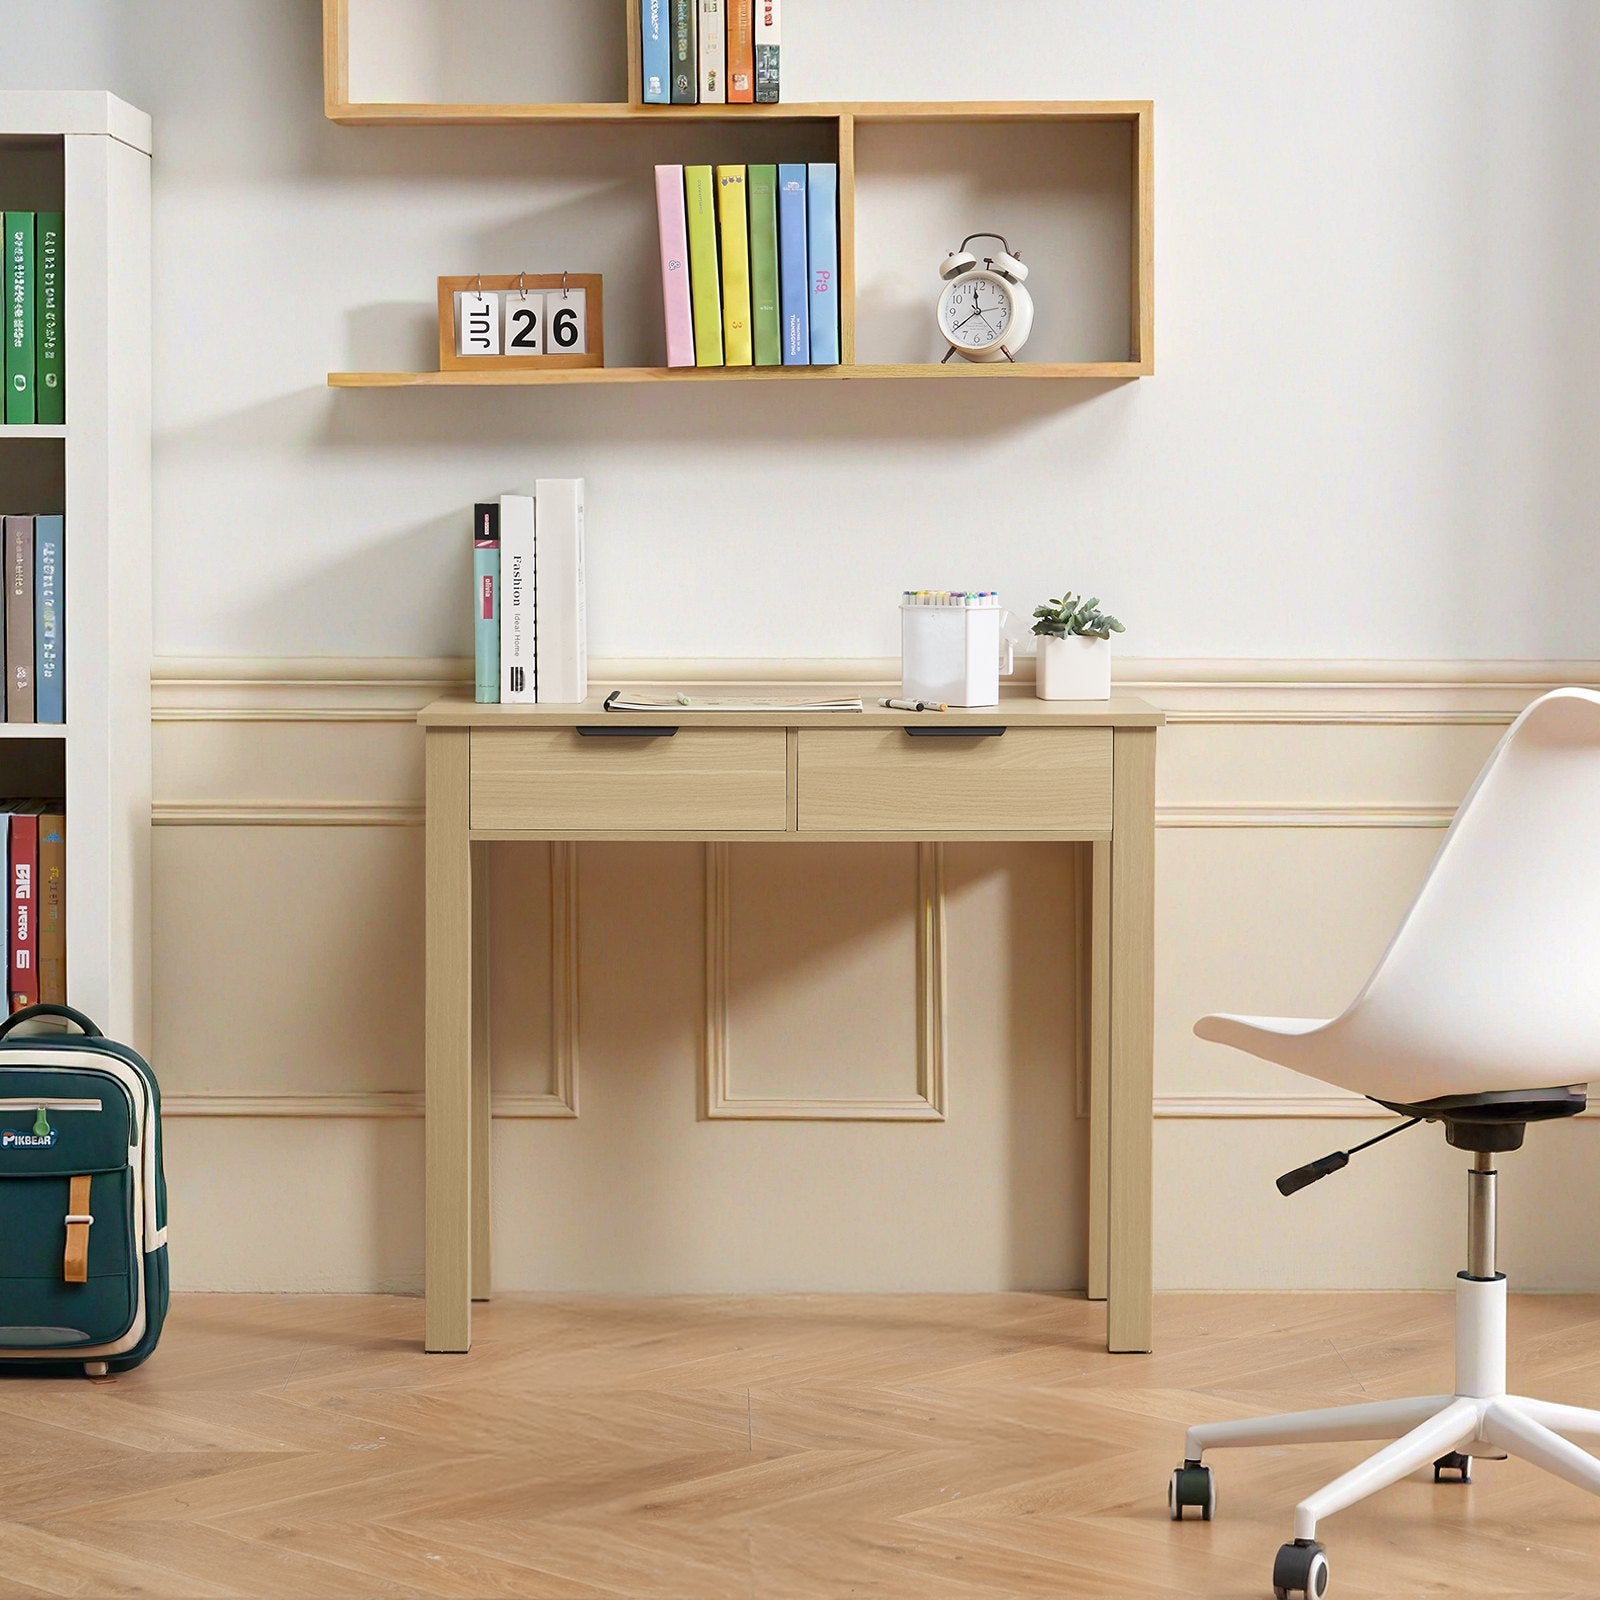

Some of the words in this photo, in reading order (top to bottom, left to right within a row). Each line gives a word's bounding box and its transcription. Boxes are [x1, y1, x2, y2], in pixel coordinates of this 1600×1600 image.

[963, 285, 971, 294] 11
[952, 295, 962, 304] 10
[998, 295, 1004, 304] 2
[949, 308, 956, 317] 9
[1001, 308, 1007, 317] 3
[470, 304, 491, 348] JUL
[996, 320, 1002, 330] 4
[962, 331, 968, 340] 7
[973, 334, 980, 343] 6
[987, 331, 993, 340] 5
[513, 555, 523, 606] Fashion
[15, 864, 31, 899] BIG
[17, 905, 28, 941] HERO
[16, 949, 30, 969] 6
[2, 1131, 51, 1146] PIKBEAR
